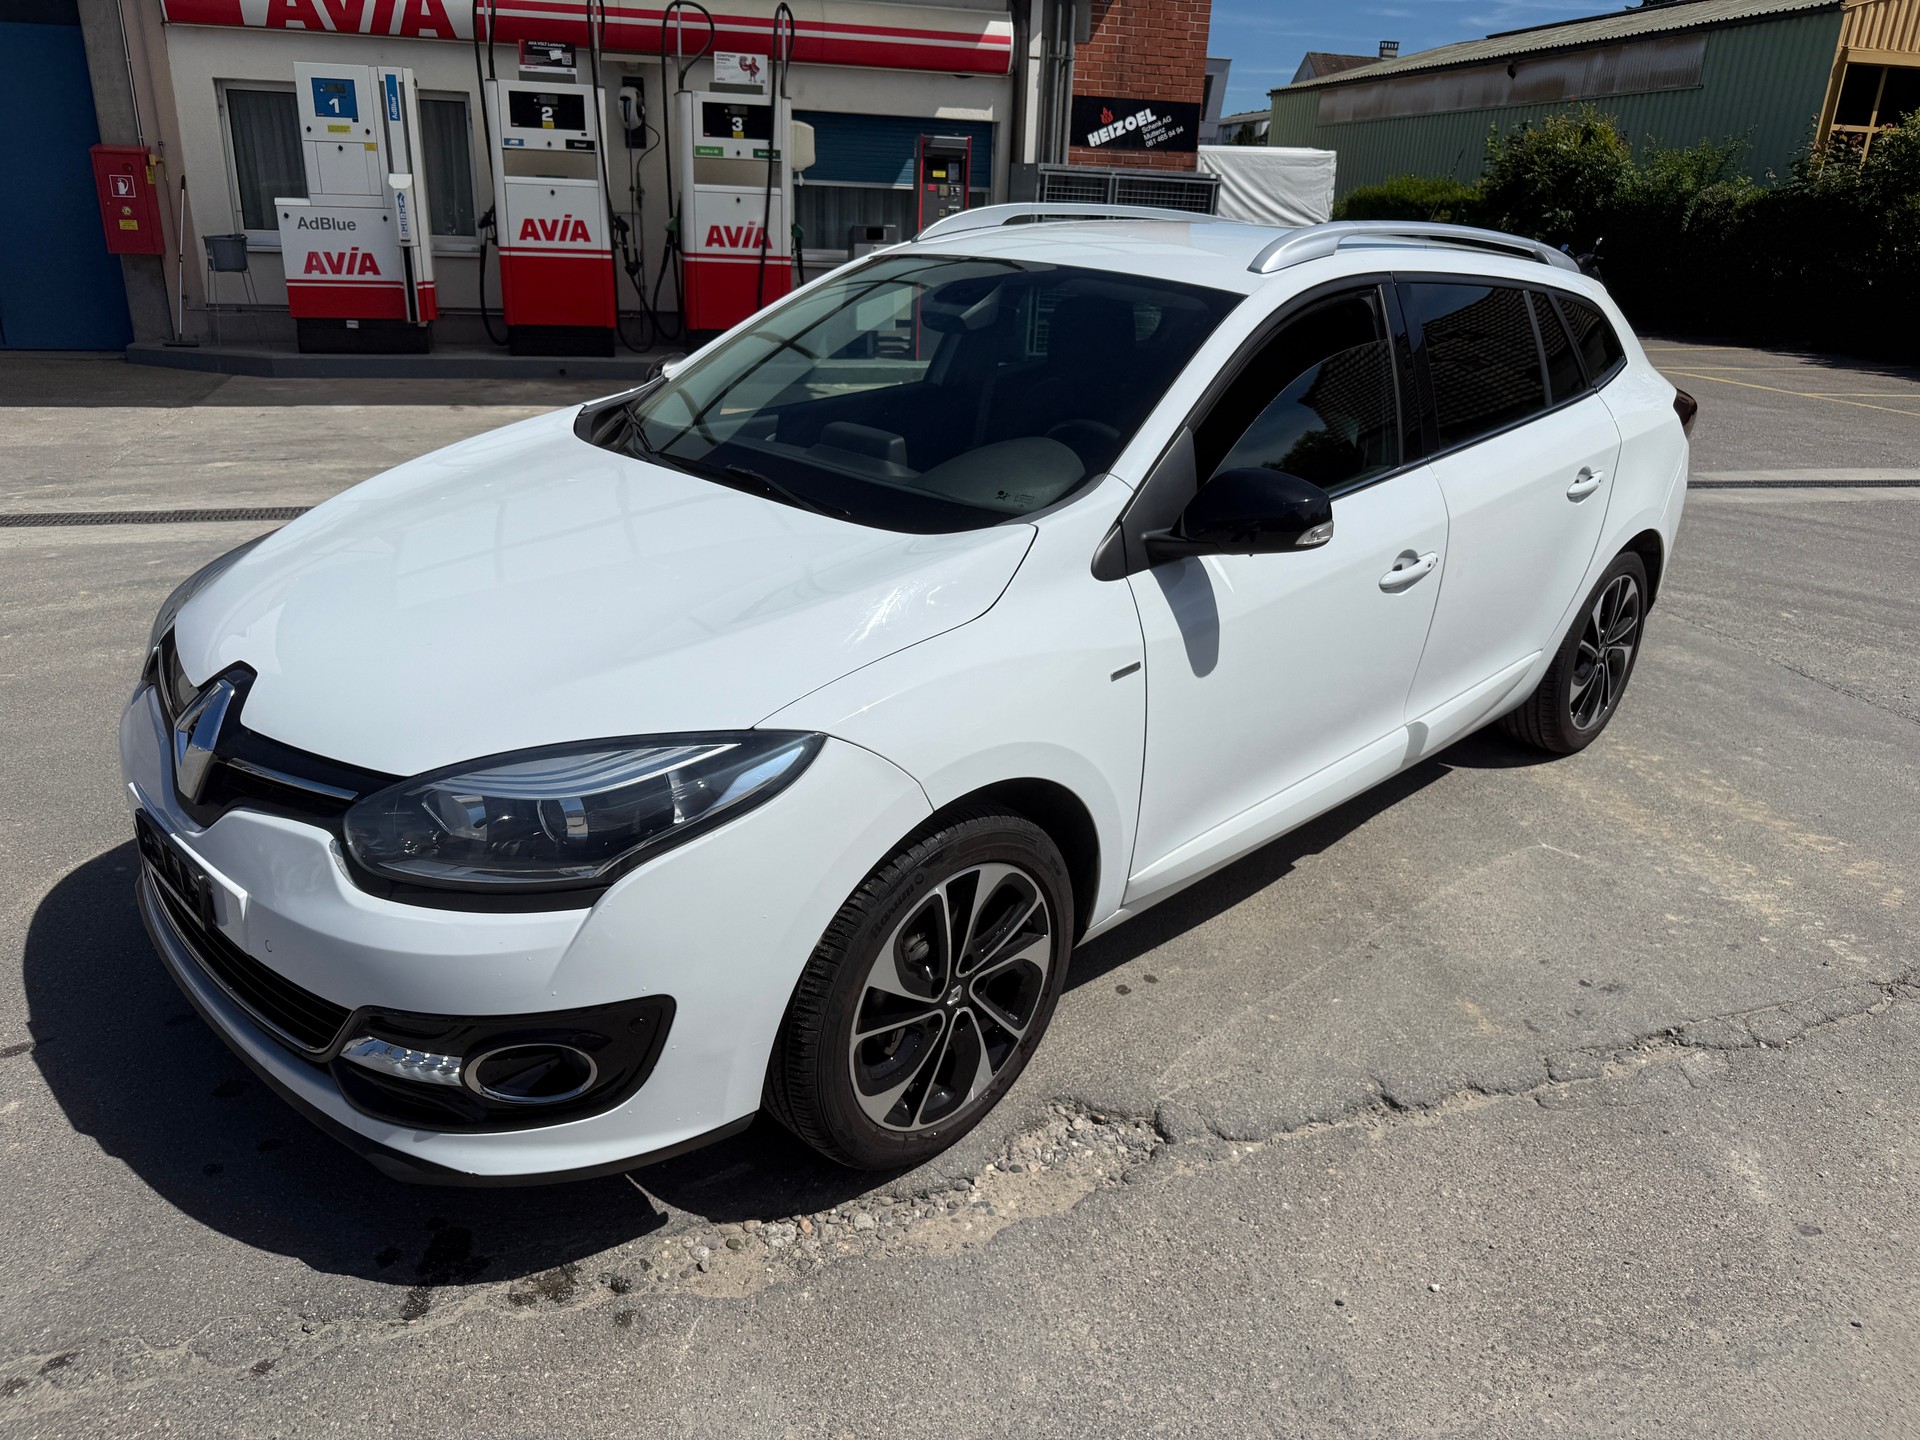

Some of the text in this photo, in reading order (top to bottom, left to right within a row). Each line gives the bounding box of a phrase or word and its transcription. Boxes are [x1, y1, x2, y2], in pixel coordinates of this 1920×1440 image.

[328, 98, 340, 114] 1
[541, 106, 554, 121] 2
[731, 116, 743, 132] 3
[1087, 108, 1157, 148] HEIZOEL
[1141, 115, 1172, 134] Schenk AG
[1143, 127, 1166, 141] Muttenz
[297, 216, 357, 231] AdBlue
[518, 214, 592, 243] AVIA
[705, 221, 774, 249] AVIA
[303, 246, 382, 276] AVIA
